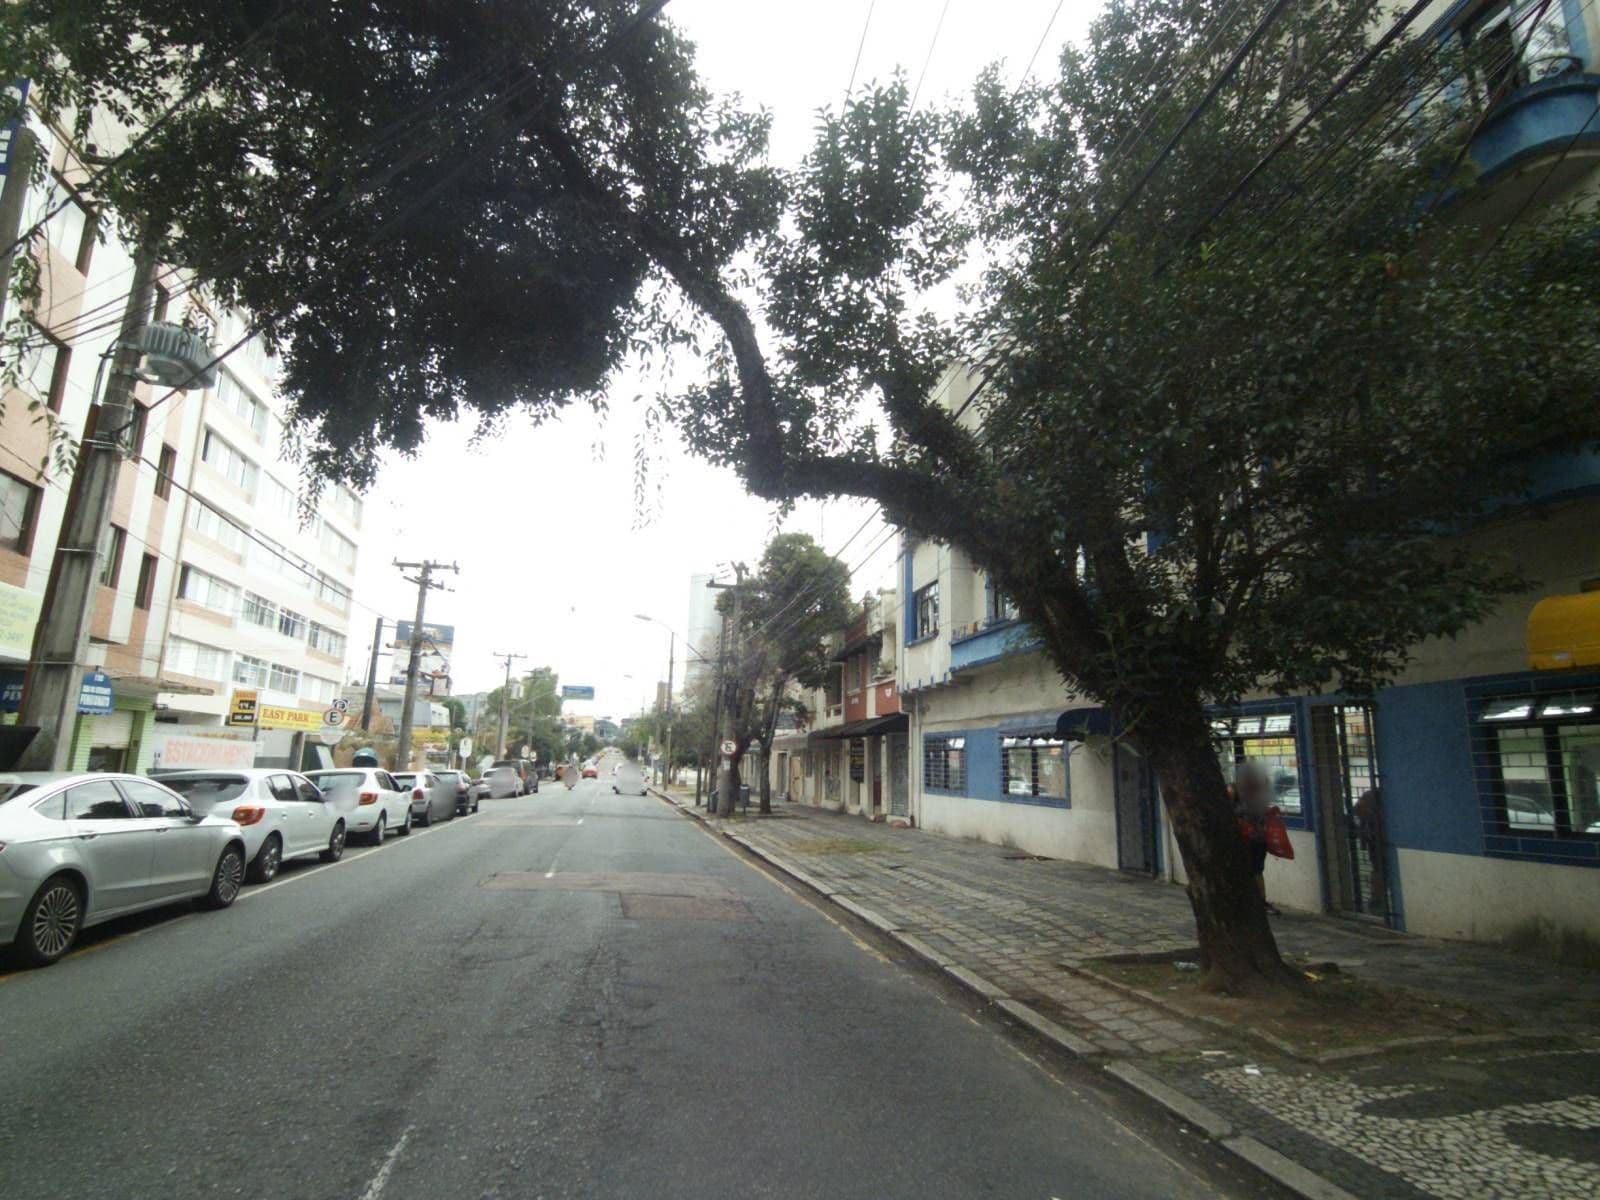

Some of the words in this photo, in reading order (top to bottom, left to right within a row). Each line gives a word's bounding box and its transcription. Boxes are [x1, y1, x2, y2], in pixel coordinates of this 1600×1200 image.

[263, 708, 284, 721] EAST
[287, 711, 309, 723] PARK
[329, 711, 337, 723] E
